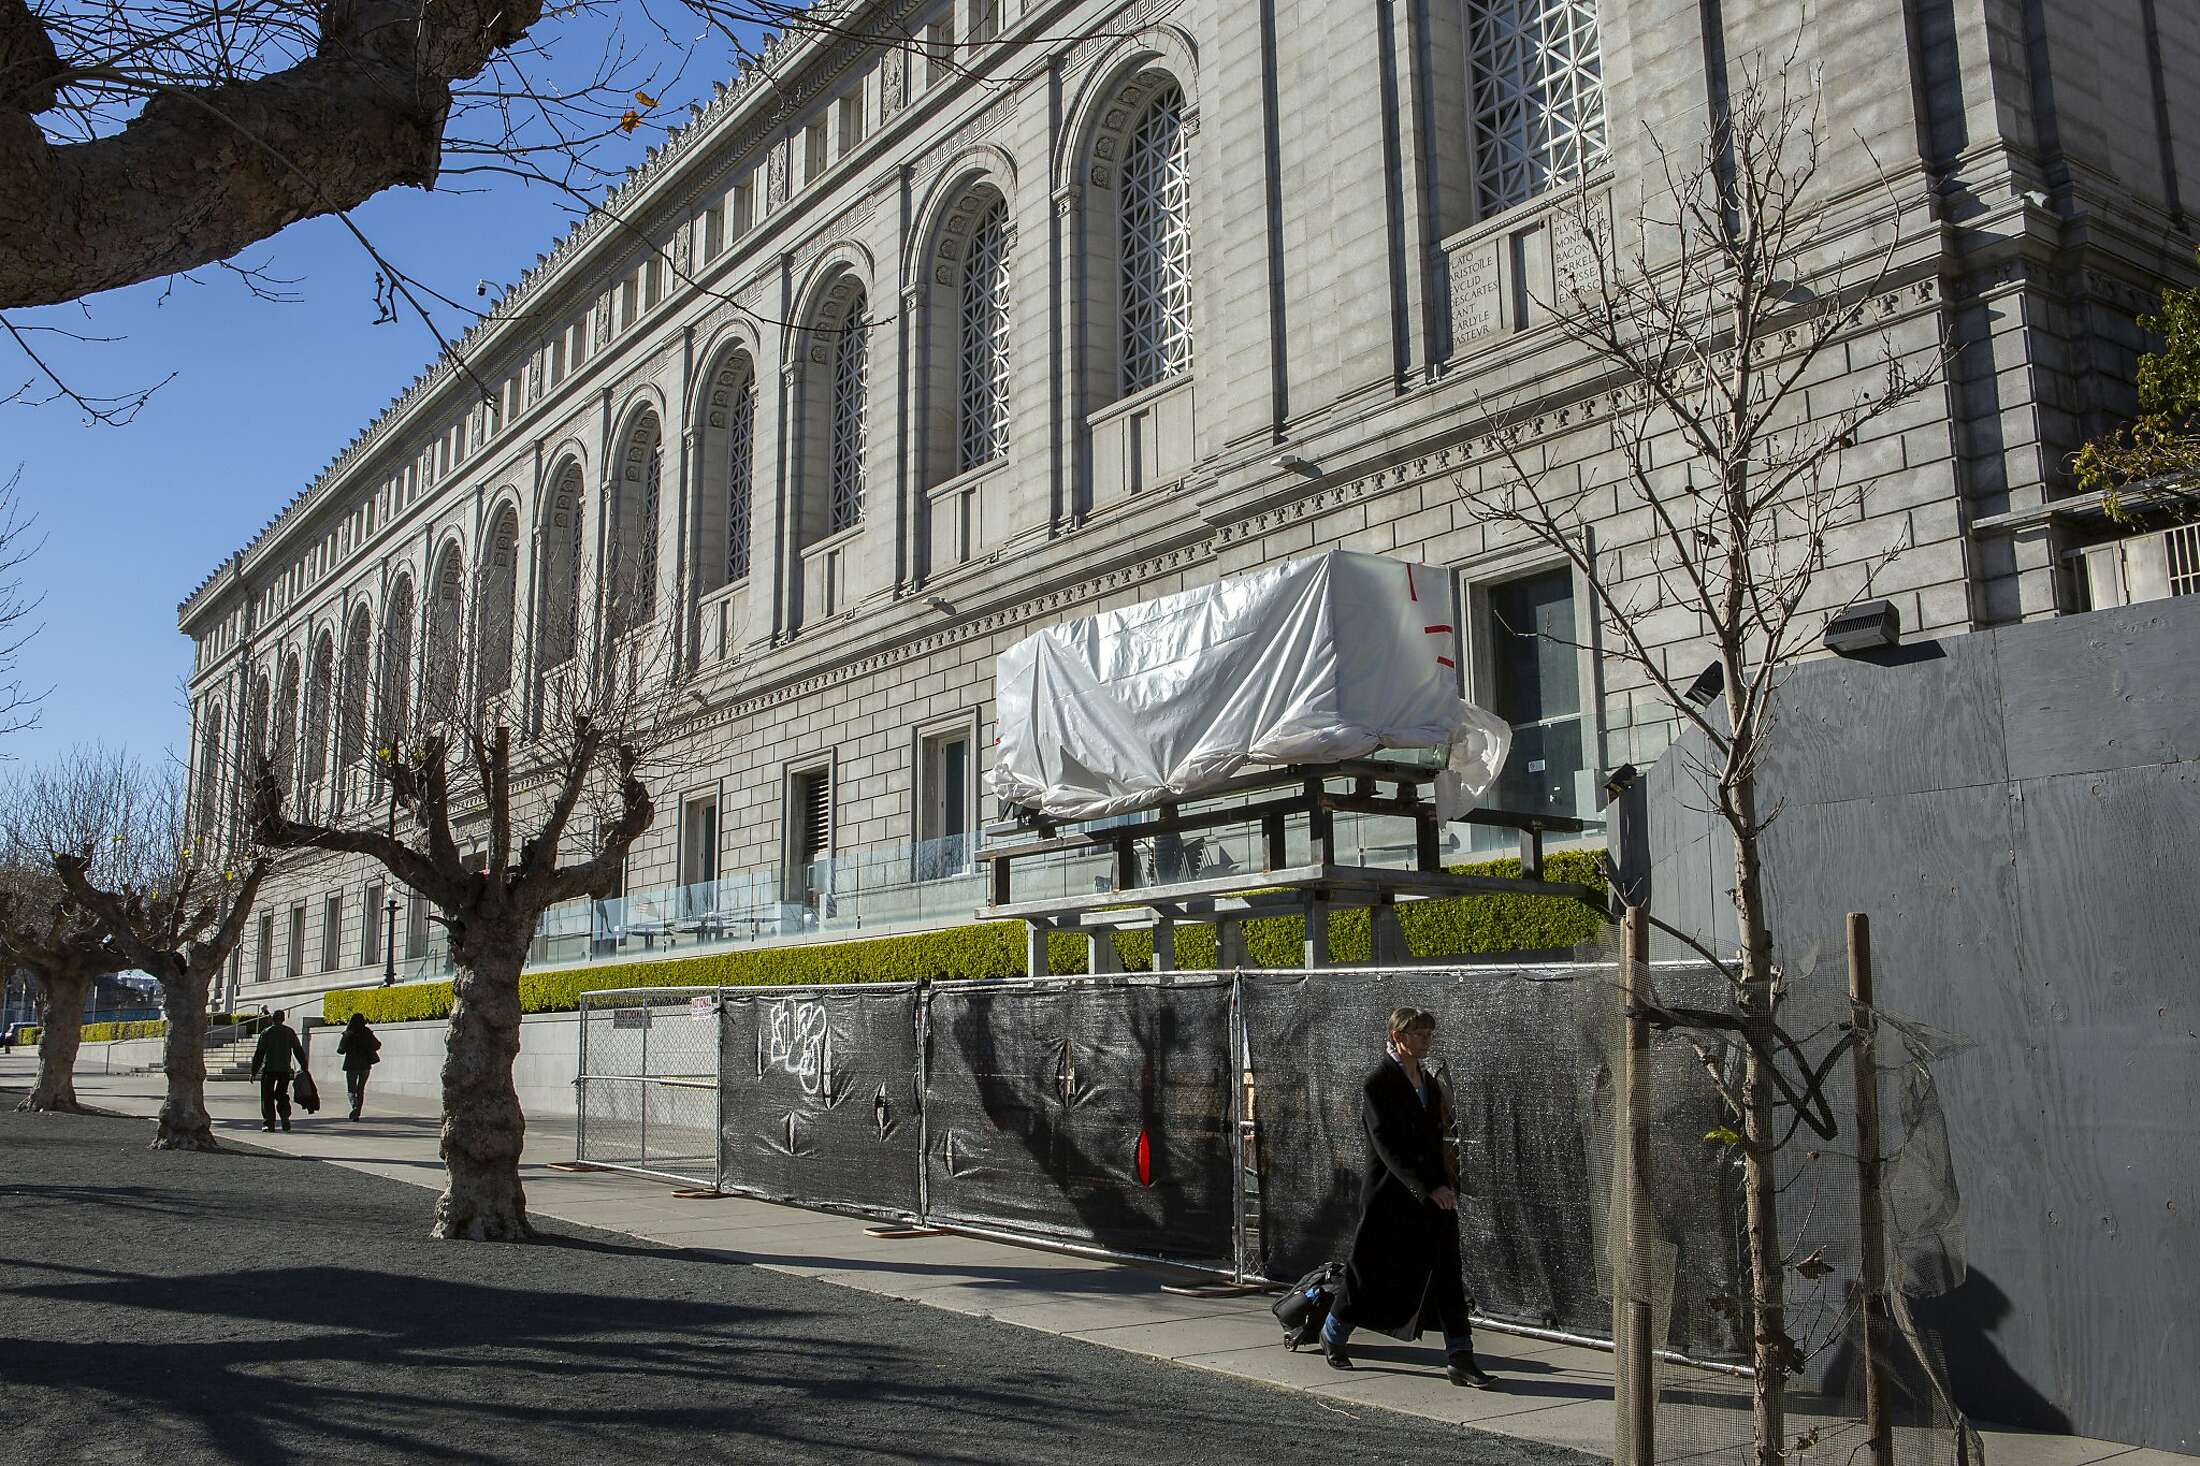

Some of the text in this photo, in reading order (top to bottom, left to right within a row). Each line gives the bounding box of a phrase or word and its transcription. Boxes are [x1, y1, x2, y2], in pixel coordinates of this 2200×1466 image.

[1555, 208, 1604, 236] PLVTACH
[1450, 252, 1474, 269] LATO
[1556, 240, 1590, 264] BACON
[1557, 246, 1606, 277] BERKEL
[1559, 275, 1609, 303] EMRSO
